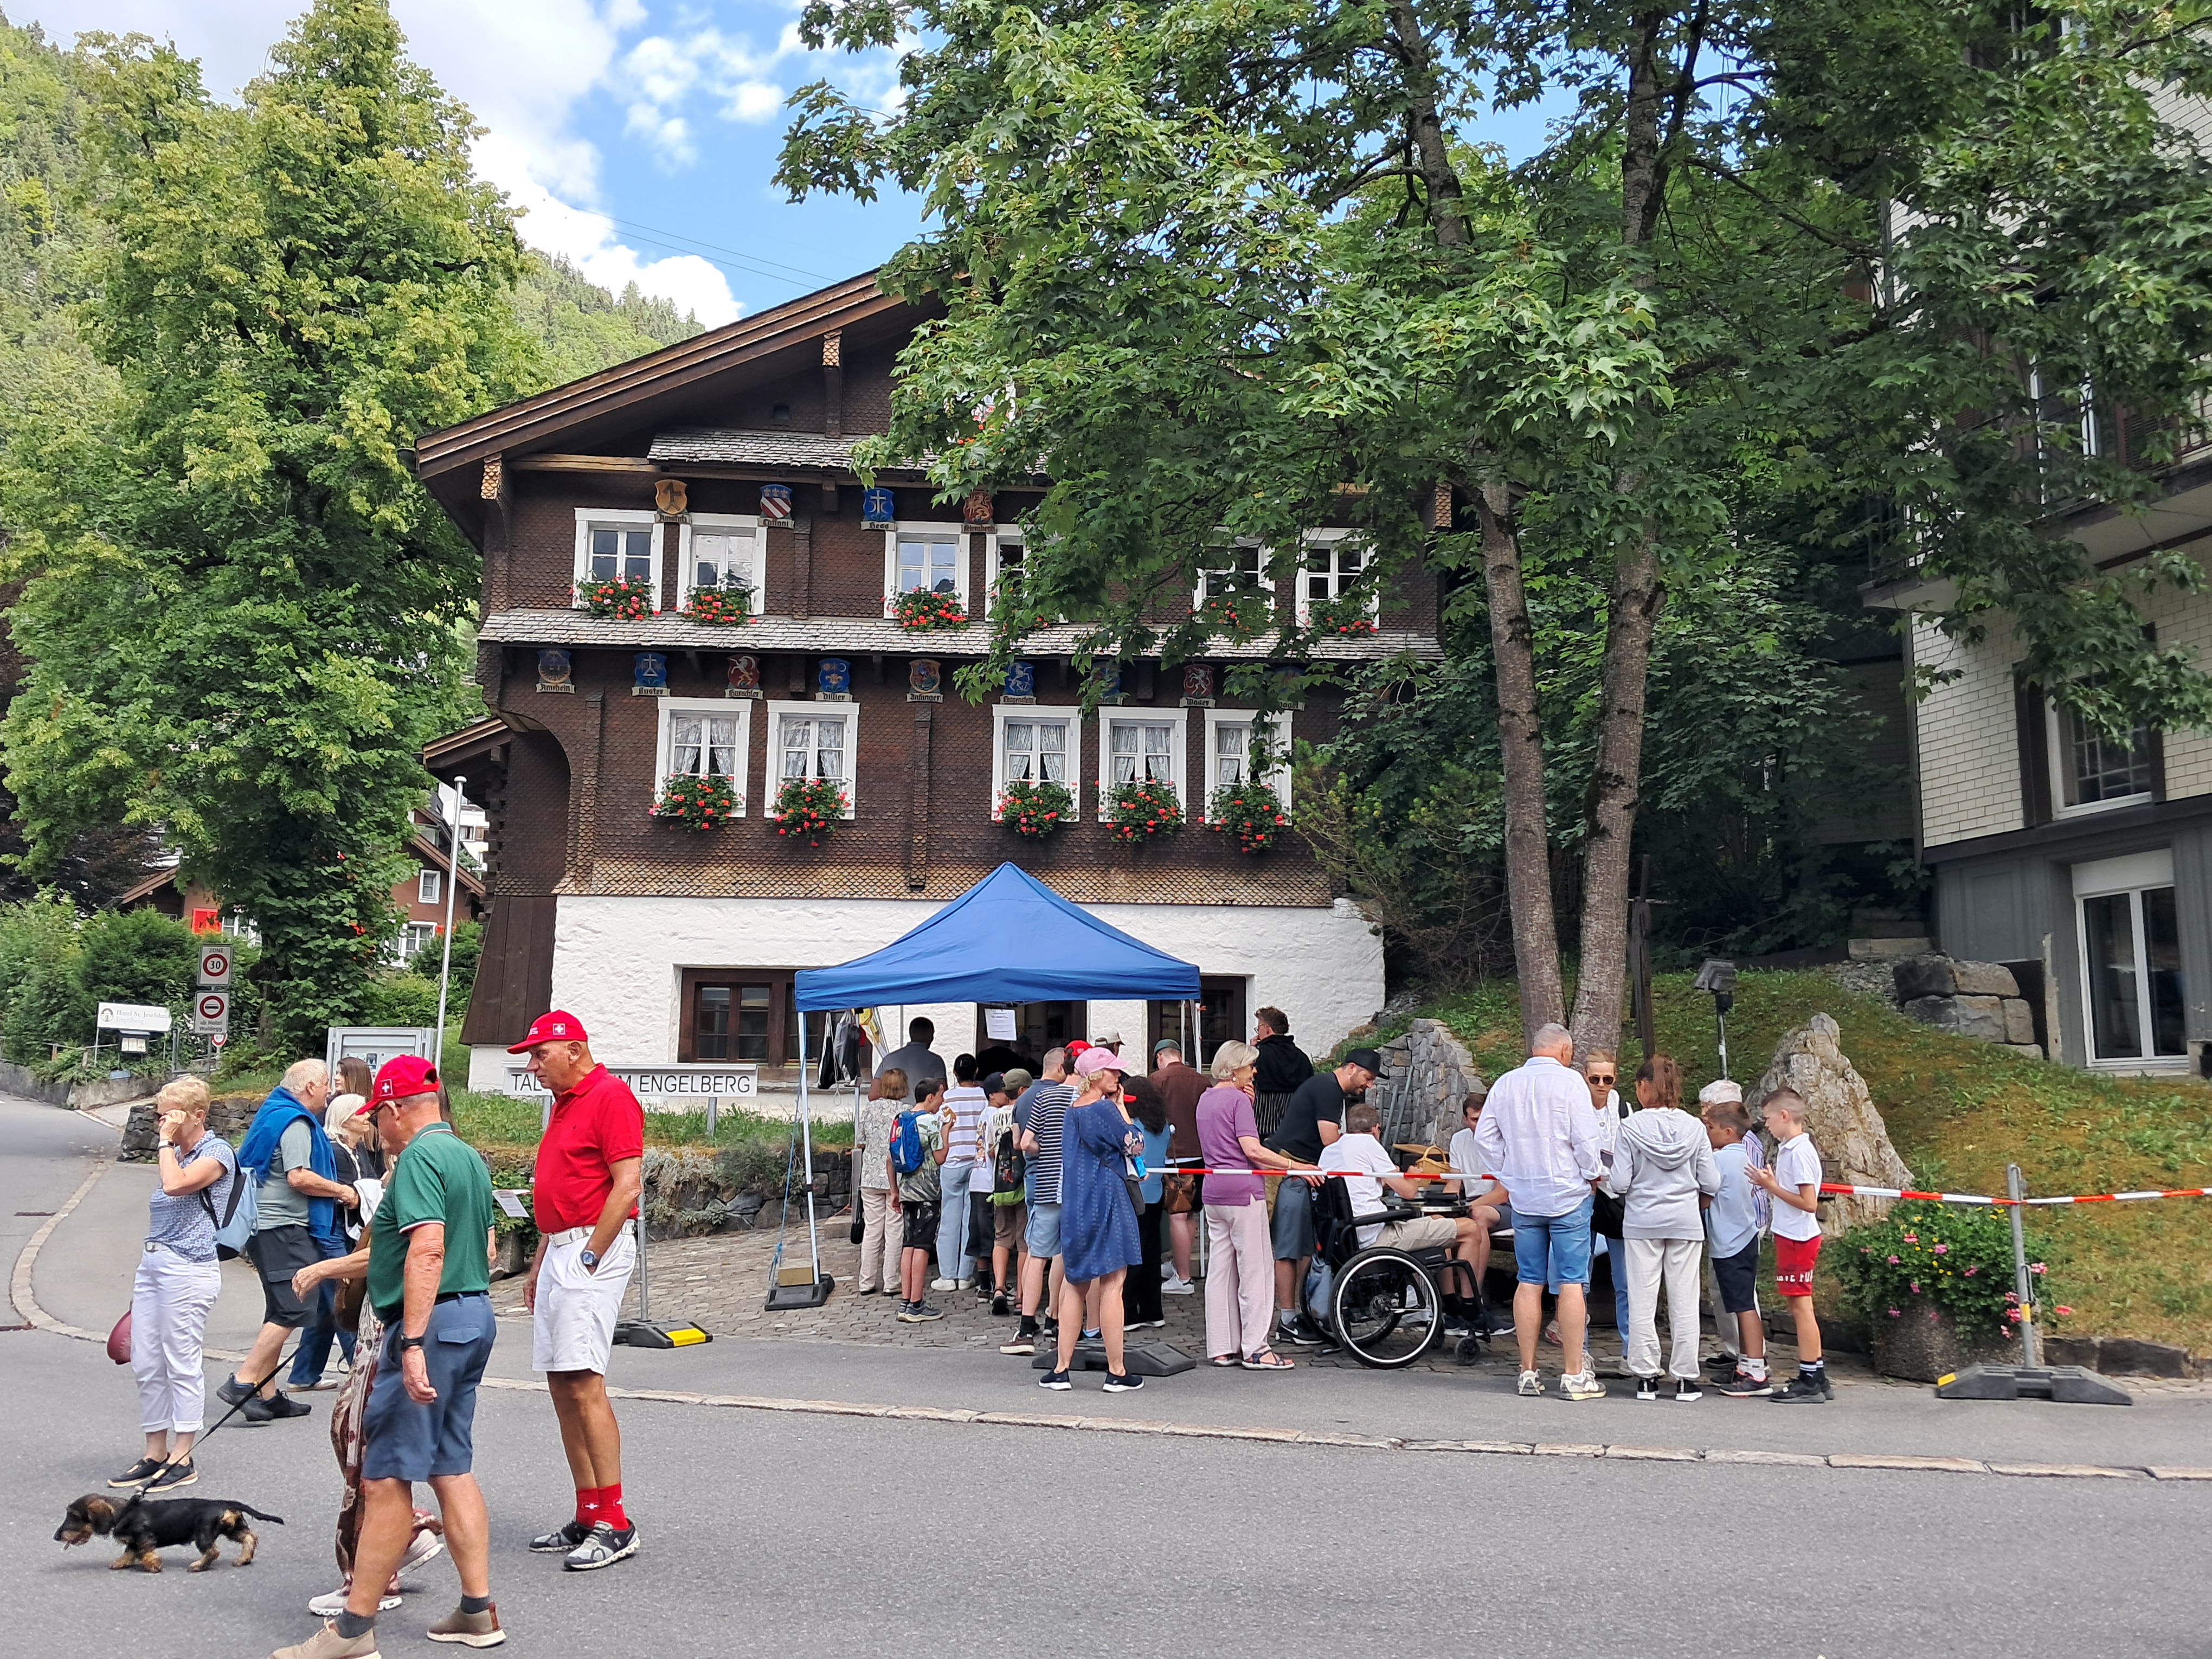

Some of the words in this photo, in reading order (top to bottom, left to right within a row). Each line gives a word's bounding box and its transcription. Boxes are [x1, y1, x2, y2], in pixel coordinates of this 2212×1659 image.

[539, 684, 570, 692] Amrhein
[1186, 698, 1209, 706] Waser
[209, 961, 221, 969] 30
[511, 1074, 542, 1091] TAL
[639, 1075, 750, 1093] ENGELBERG
